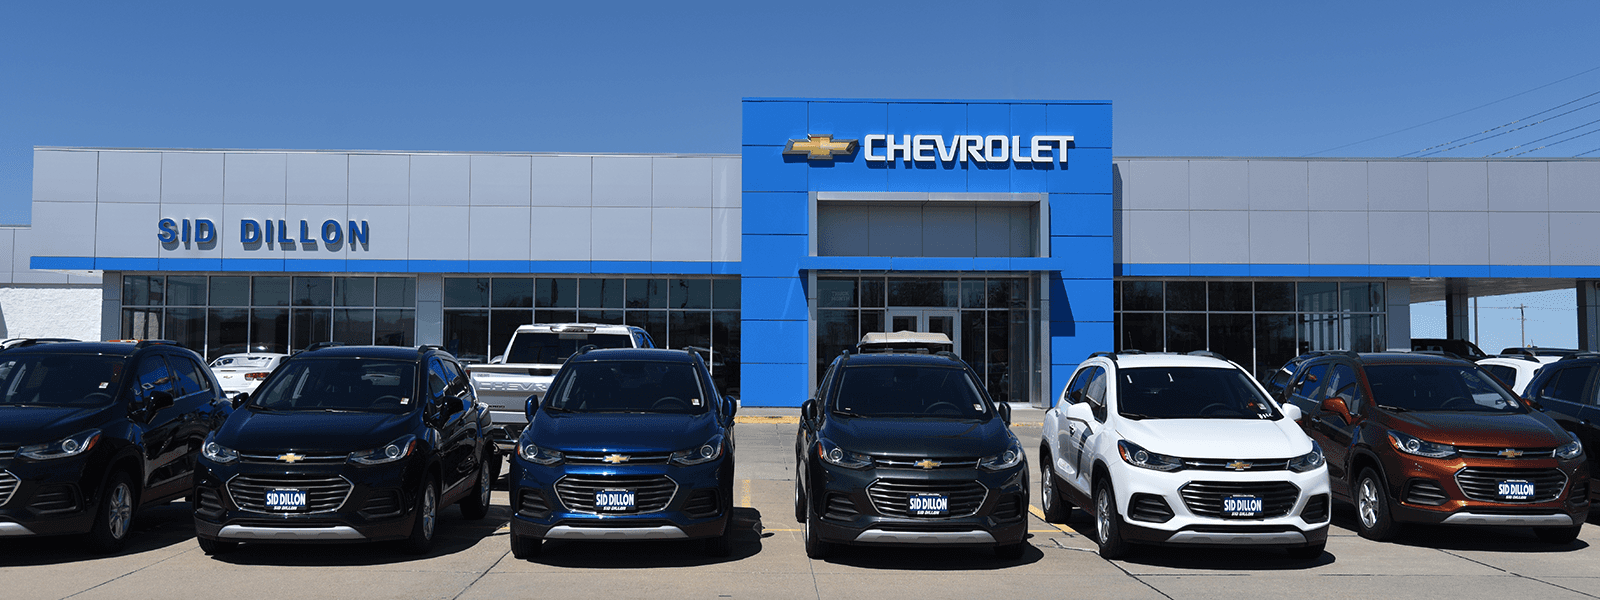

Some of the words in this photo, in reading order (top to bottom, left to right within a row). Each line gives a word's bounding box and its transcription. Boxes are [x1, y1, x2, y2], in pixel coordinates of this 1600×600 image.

[864, 134, 1075, 163] CHEVROLET
[157, 218, 214, 244] SID
[240, 219, 368, 245] DILLON
[479, 382, 549, 392] CHEVR
[1499, 484, 1510, 495] SID
[1510, 484, 1534, 496] DILLON
[266, 493, 279, 505] SID
[279, 493, 306, 505] DILLON
[595, 494, 608, 506] SID
[608, 494, 634, 506] DILLON
[909, 498, 921, 510] SID
[922, 498, 947, 510] DILLON
[1224, 500, 1236, 511] SID
[1236, 500, 1262, 511] DILLON
